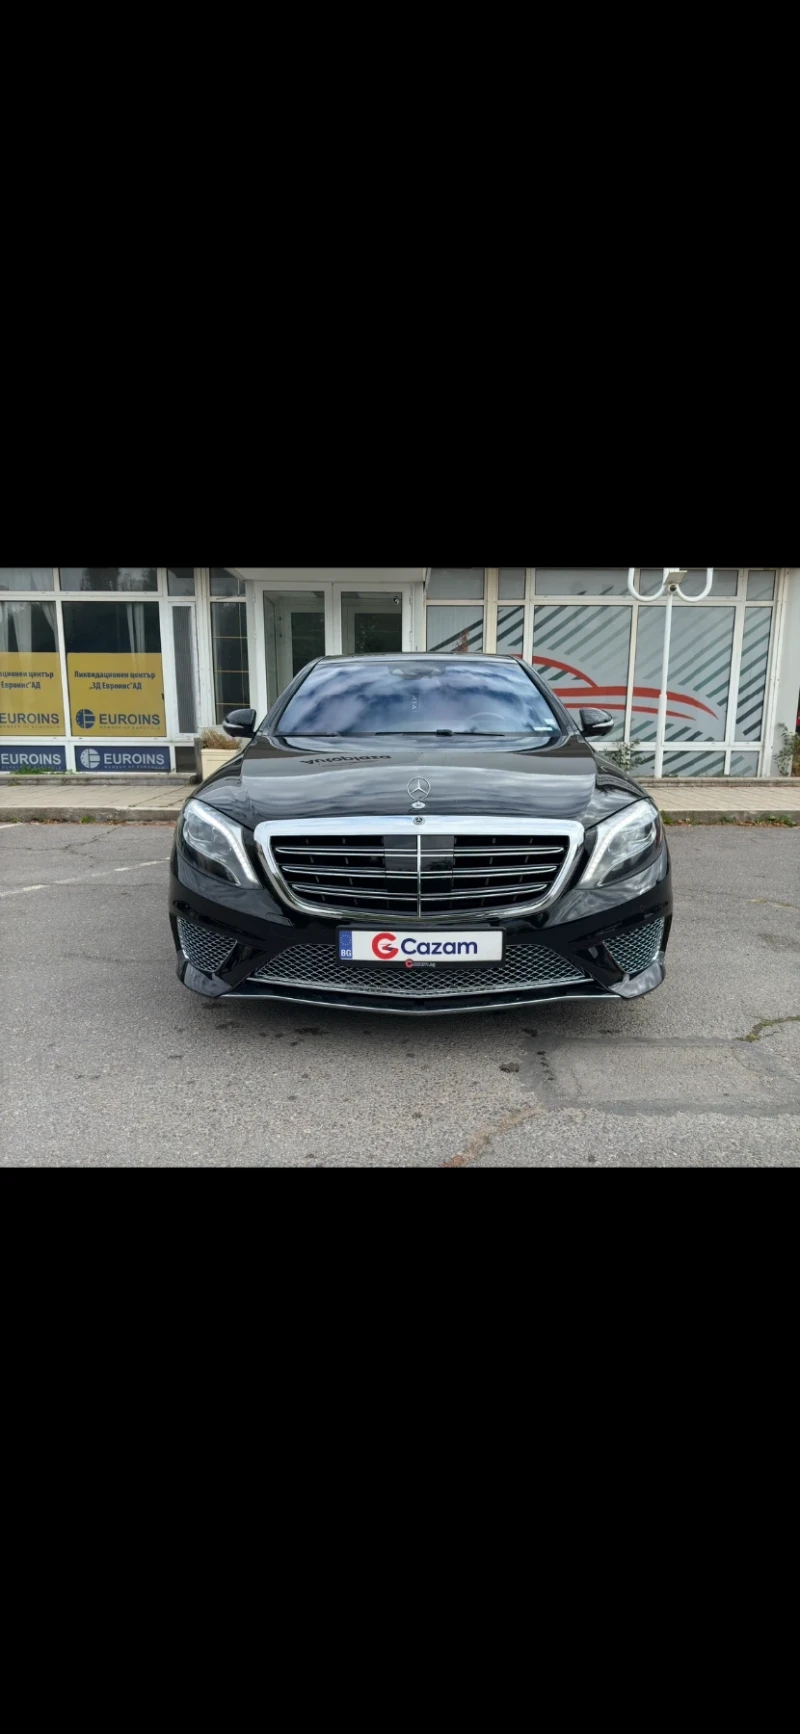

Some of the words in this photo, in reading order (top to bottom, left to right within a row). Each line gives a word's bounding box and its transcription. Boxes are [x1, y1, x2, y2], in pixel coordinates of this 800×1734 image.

[0, 713, 59, 724] EUROINS
[99, 714, 160, 725] EUROINS
[1, 753, 61, 765] EUROINS
[104, 753, 164, 765] EUROINS
[401, 938, 477, 955] Cazam
